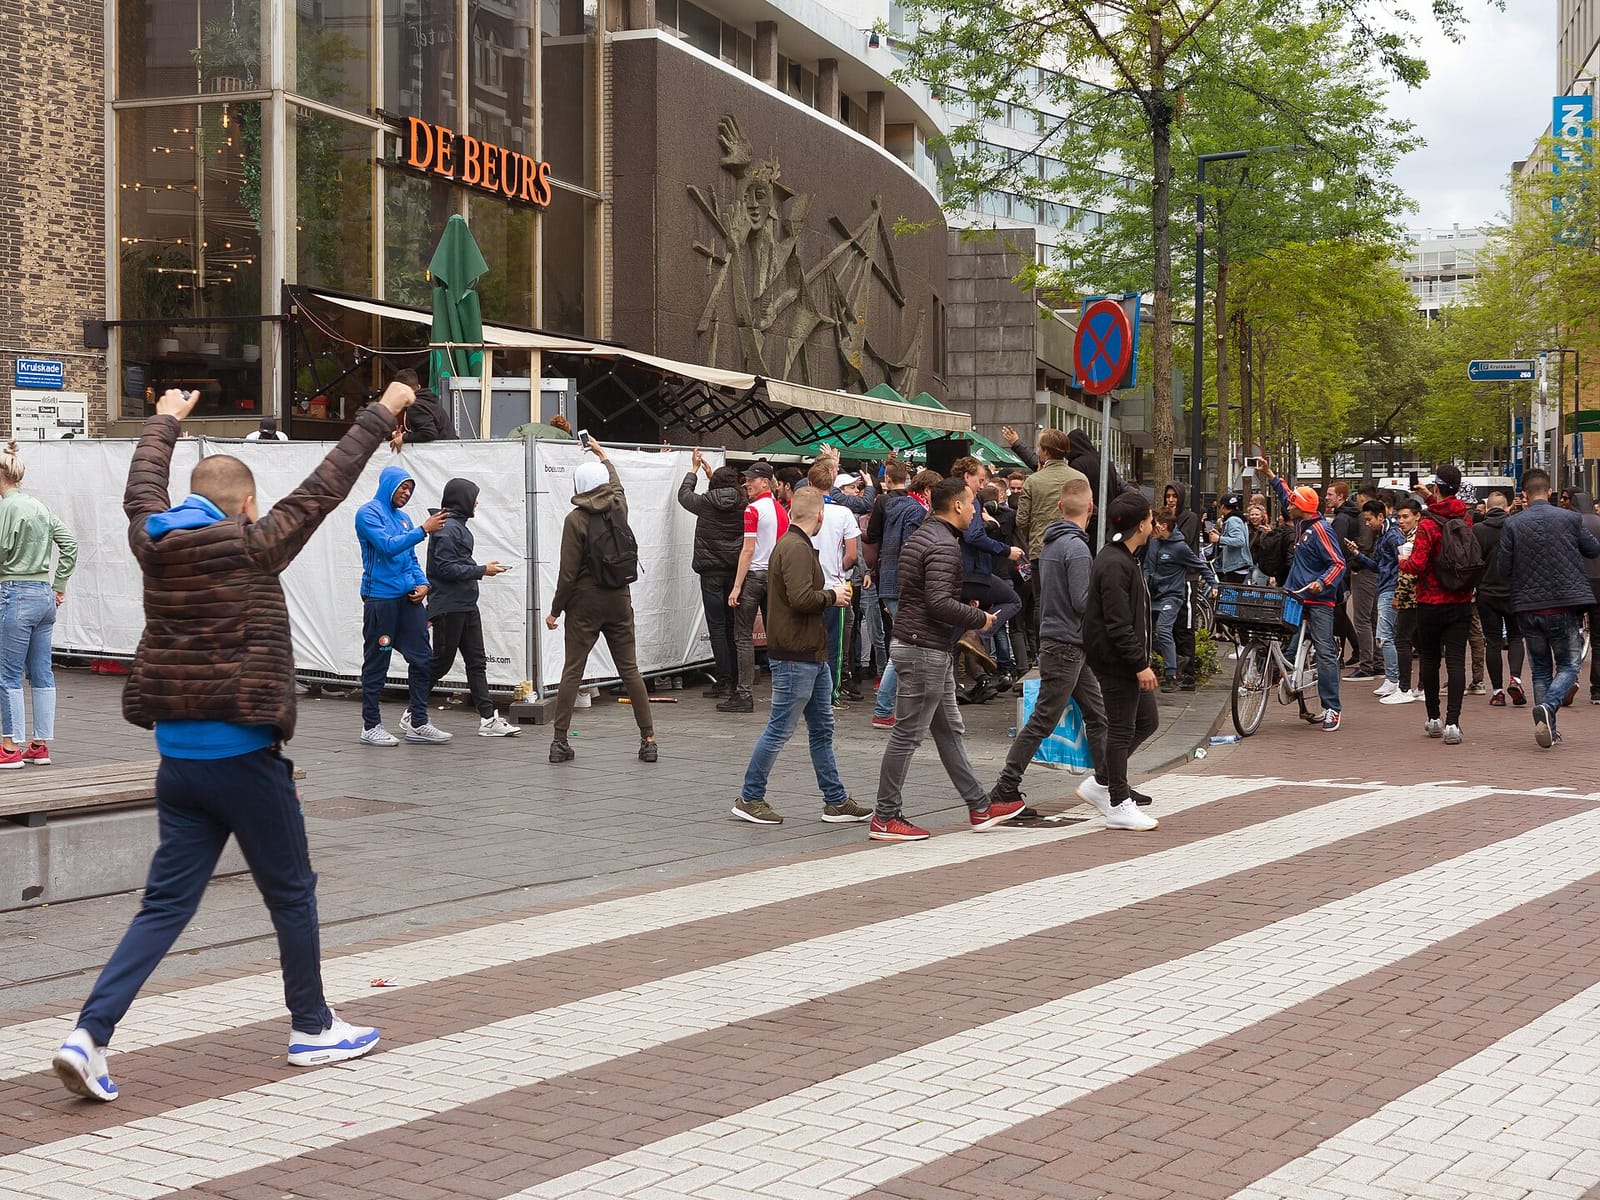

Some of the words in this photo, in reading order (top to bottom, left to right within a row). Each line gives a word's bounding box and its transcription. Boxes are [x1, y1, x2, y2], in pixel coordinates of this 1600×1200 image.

[408, 116, 454, 176] DE
[462, 134, 551, 207] BEURS
[20, 362, 60, 373] Kruiskade
[486, 655, 510, 664] els.com
